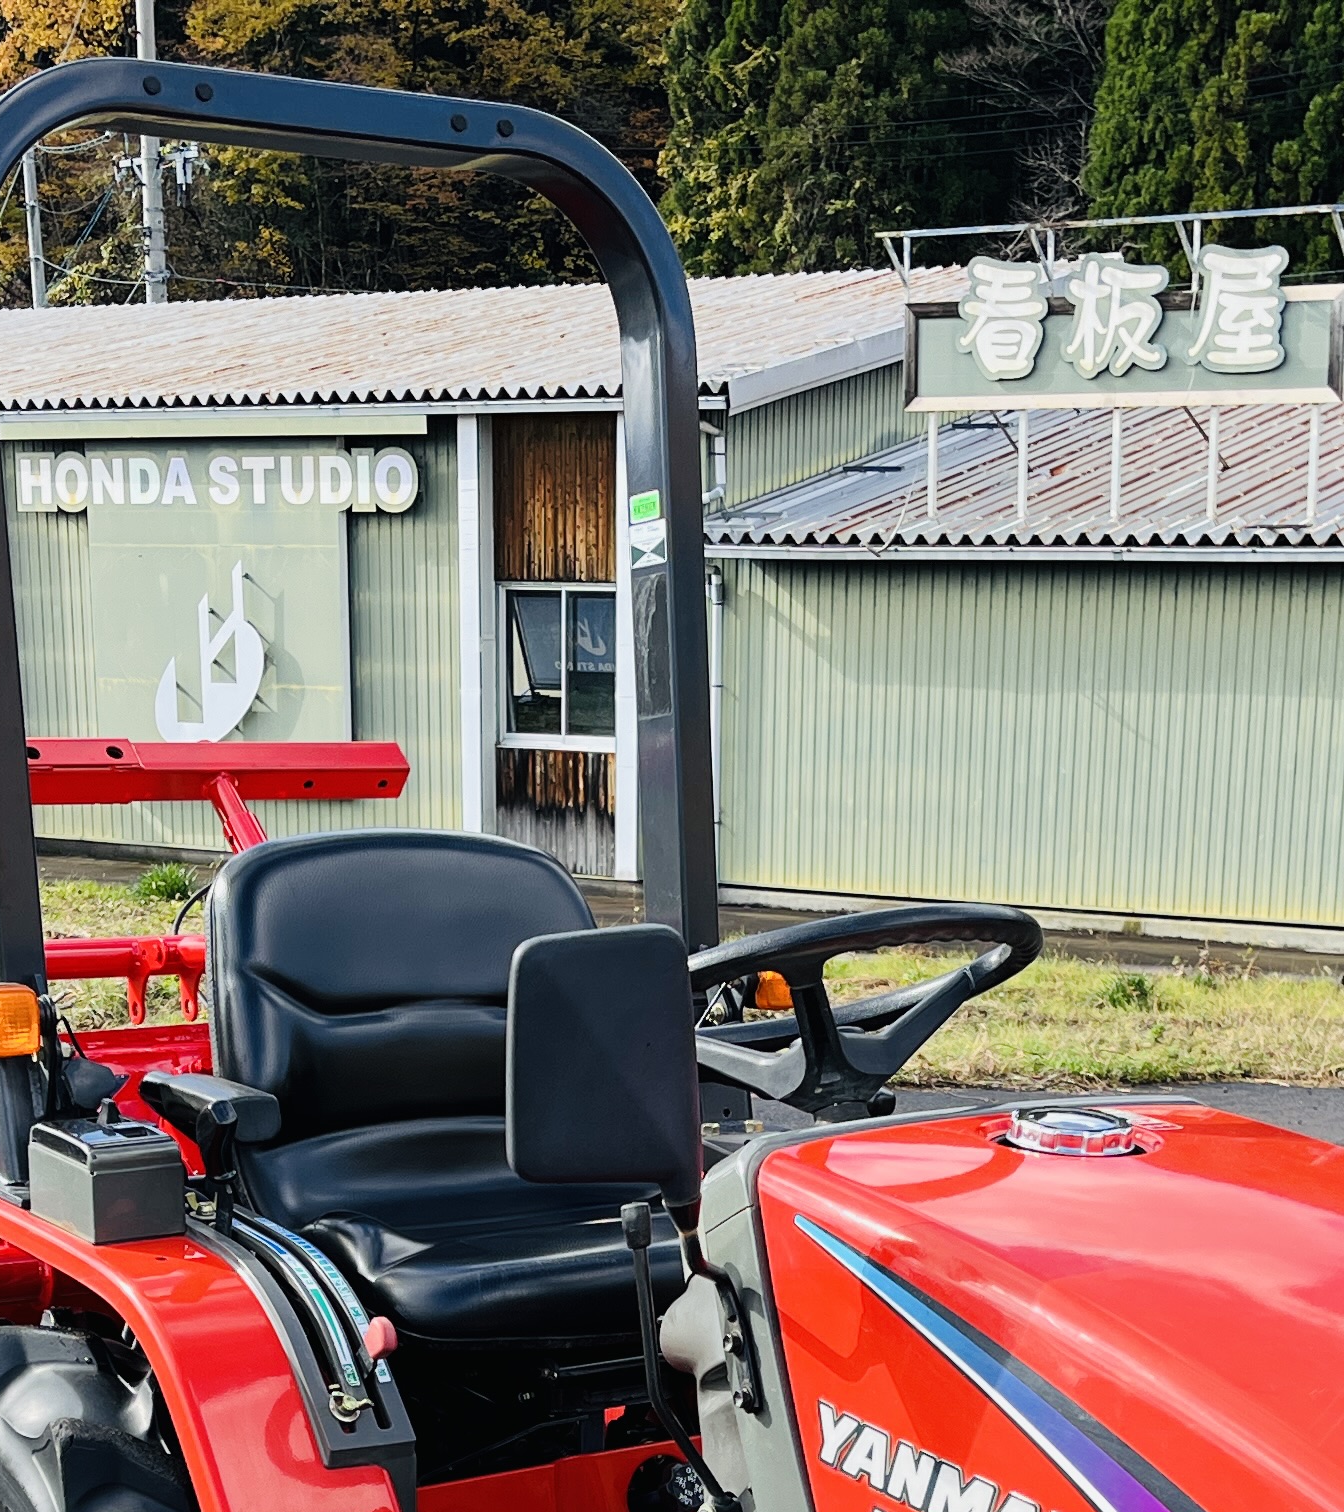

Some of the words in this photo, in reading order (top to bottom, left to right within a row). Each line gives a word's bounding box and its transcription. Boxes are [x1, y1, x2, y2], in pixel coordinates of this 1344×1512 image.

[959, 246, 1285, 376] 看板屋
[19, 455, 197, 506] HONDA
[208, 453, 414, 506] STUDIO
